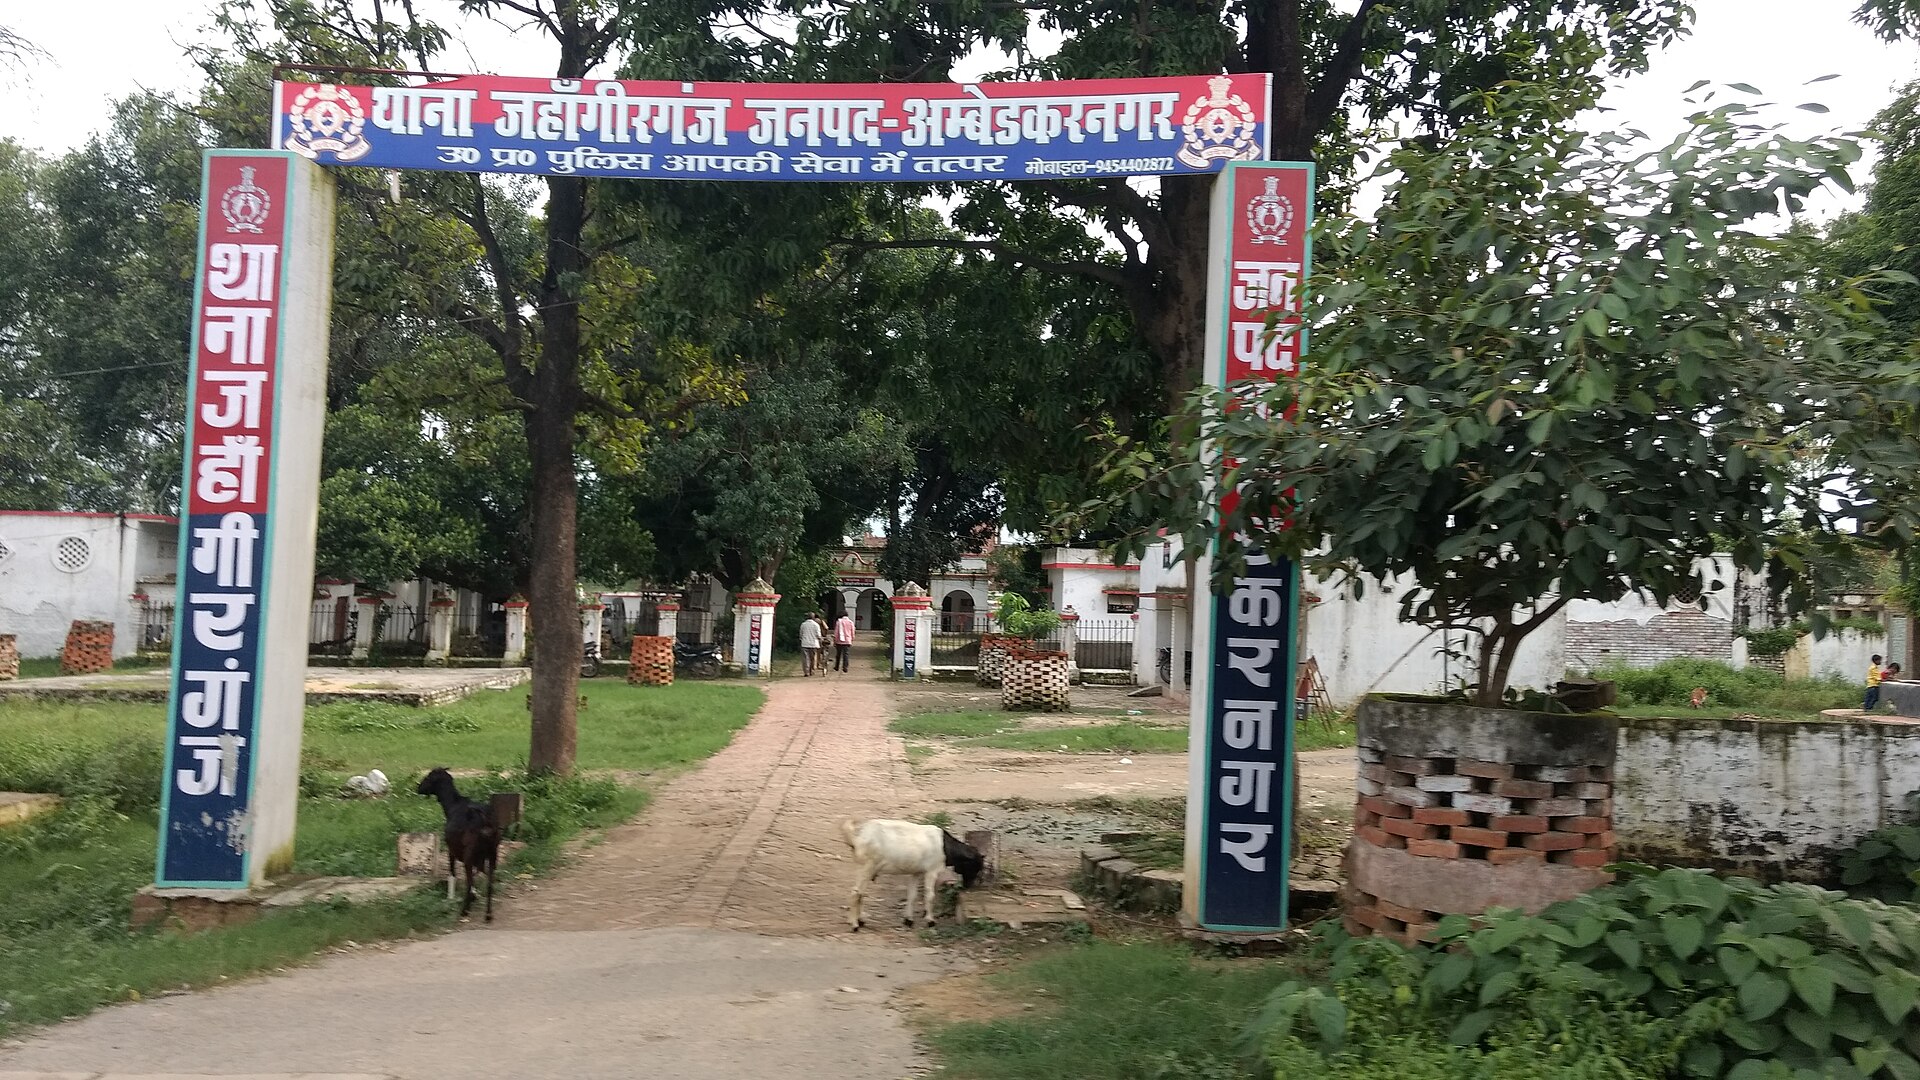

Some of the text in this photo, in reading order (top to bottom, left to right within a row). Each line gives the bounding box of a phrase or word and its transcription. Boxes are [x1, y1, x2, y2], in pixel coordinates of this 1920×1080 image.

[545, 146, 655, 175] पुलिस
[660, 150, 784, 173] आपकी
[790, 151, 863, 174] सेवा
[870, 150, 909, 174] में
[912, 155, 1009, 174] तत्पर
